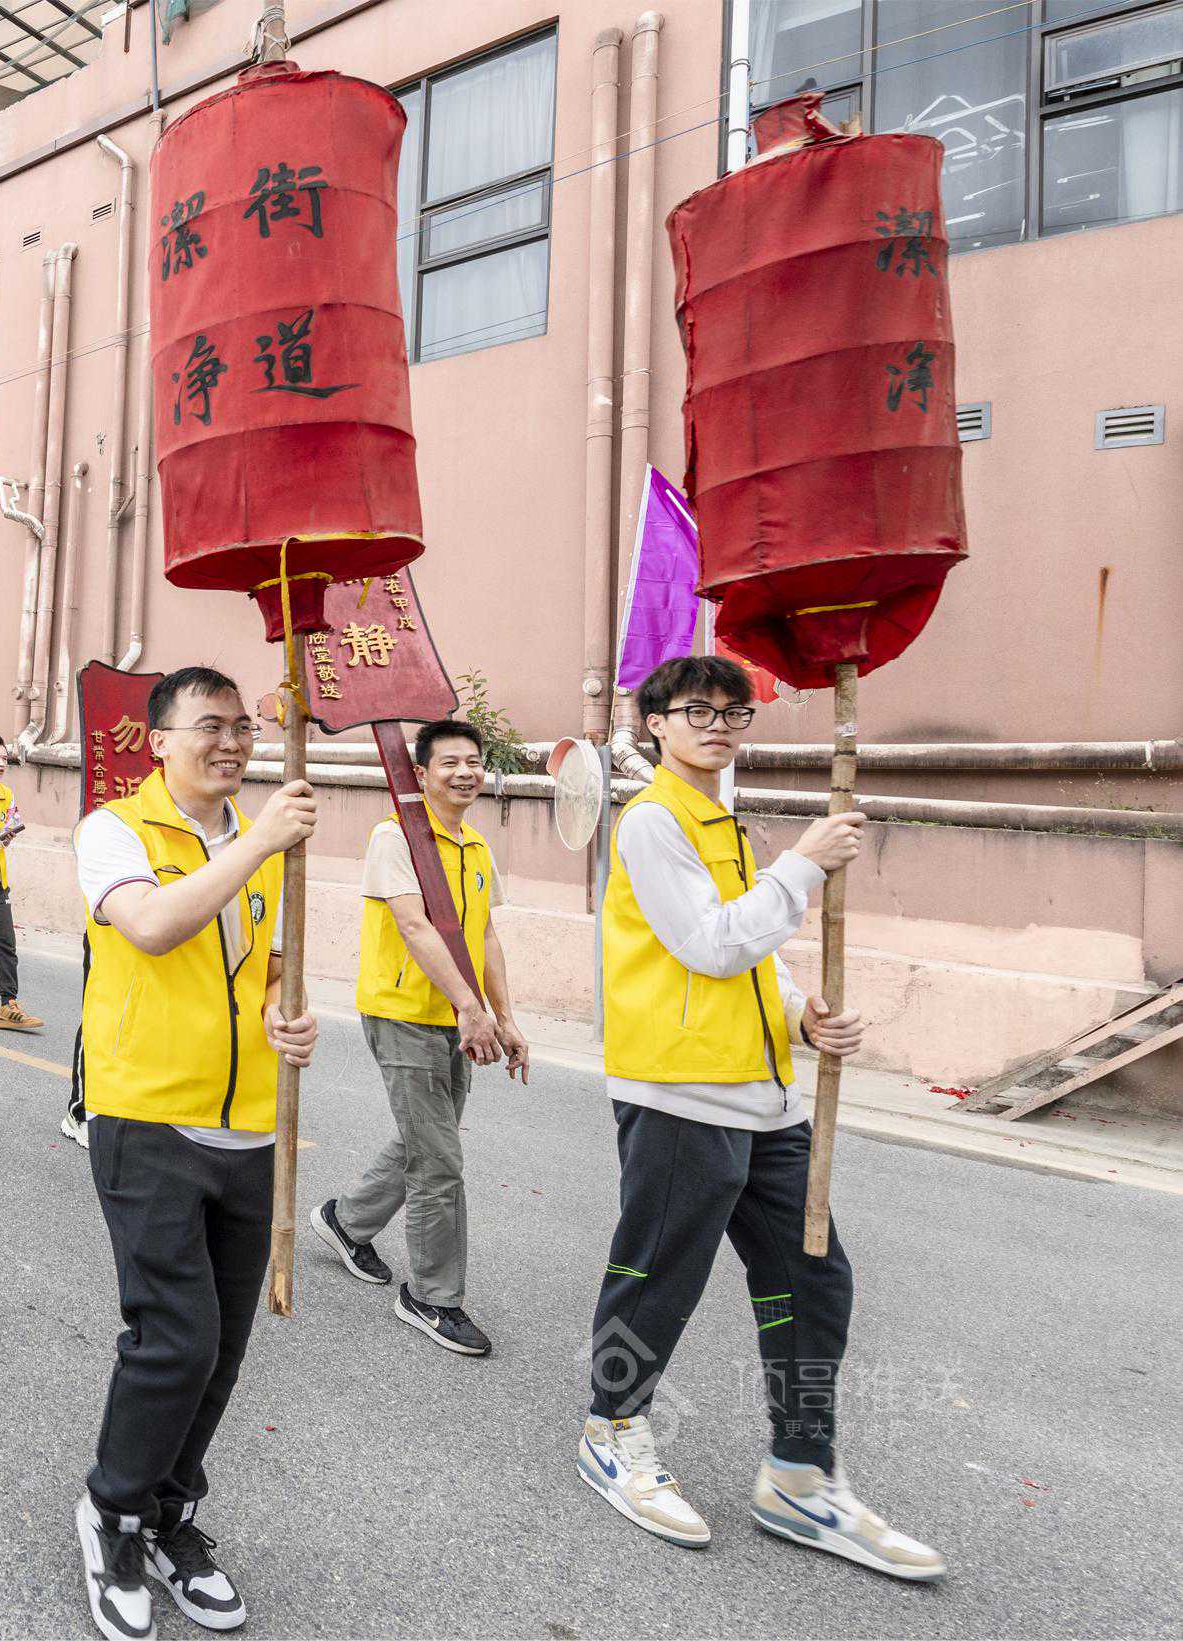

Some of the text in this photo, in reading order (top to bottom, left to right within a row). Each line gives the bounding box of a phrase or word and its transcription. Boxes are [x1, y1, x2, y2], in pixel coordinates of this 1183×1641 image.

[243, 162, 362, 398] 街道
[384, 573, 418, 631] 在甲戌
